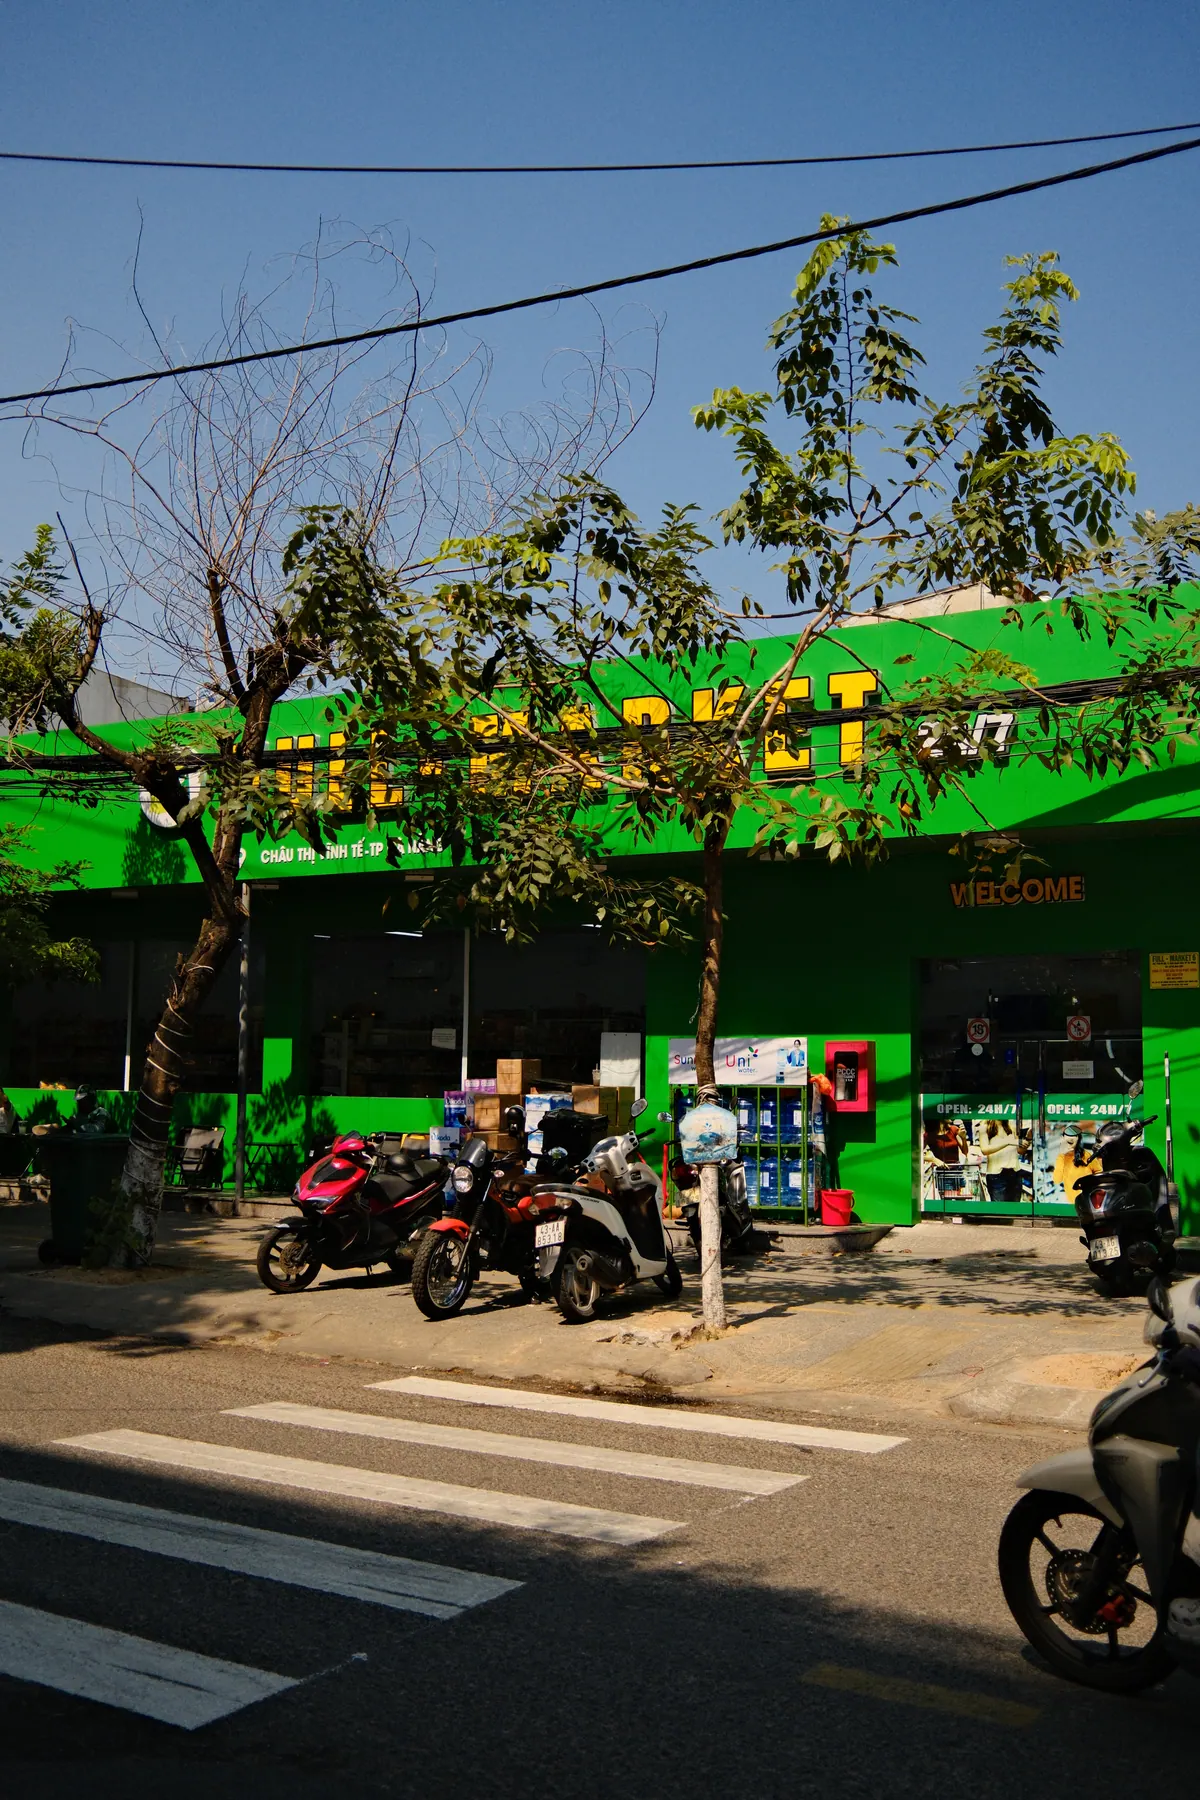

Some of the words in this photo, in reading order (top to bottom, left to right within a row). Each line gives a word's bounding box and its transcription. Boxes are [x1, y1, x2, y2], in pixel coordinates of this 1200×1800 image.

[917, 712, 1014, 758] 2/7
[261, 845, 294, 864] CHÂU
[297, 846, 316, 865] THỊ
[318, 842, 348, 861] ĨNH
[949, 876, 1085, 907] WELCOME
[725, 1053, 751, 1068] Uni
[836, 1068, 856, 1076] PCCC
[936, 1103, 972, 1114] OPEN:
[1047, 1104, 1084, 1115] OPEN:
[1090, 1103, 1132, 1115] 24H/7
[540, 1222, 560, 1235] 43-AA
